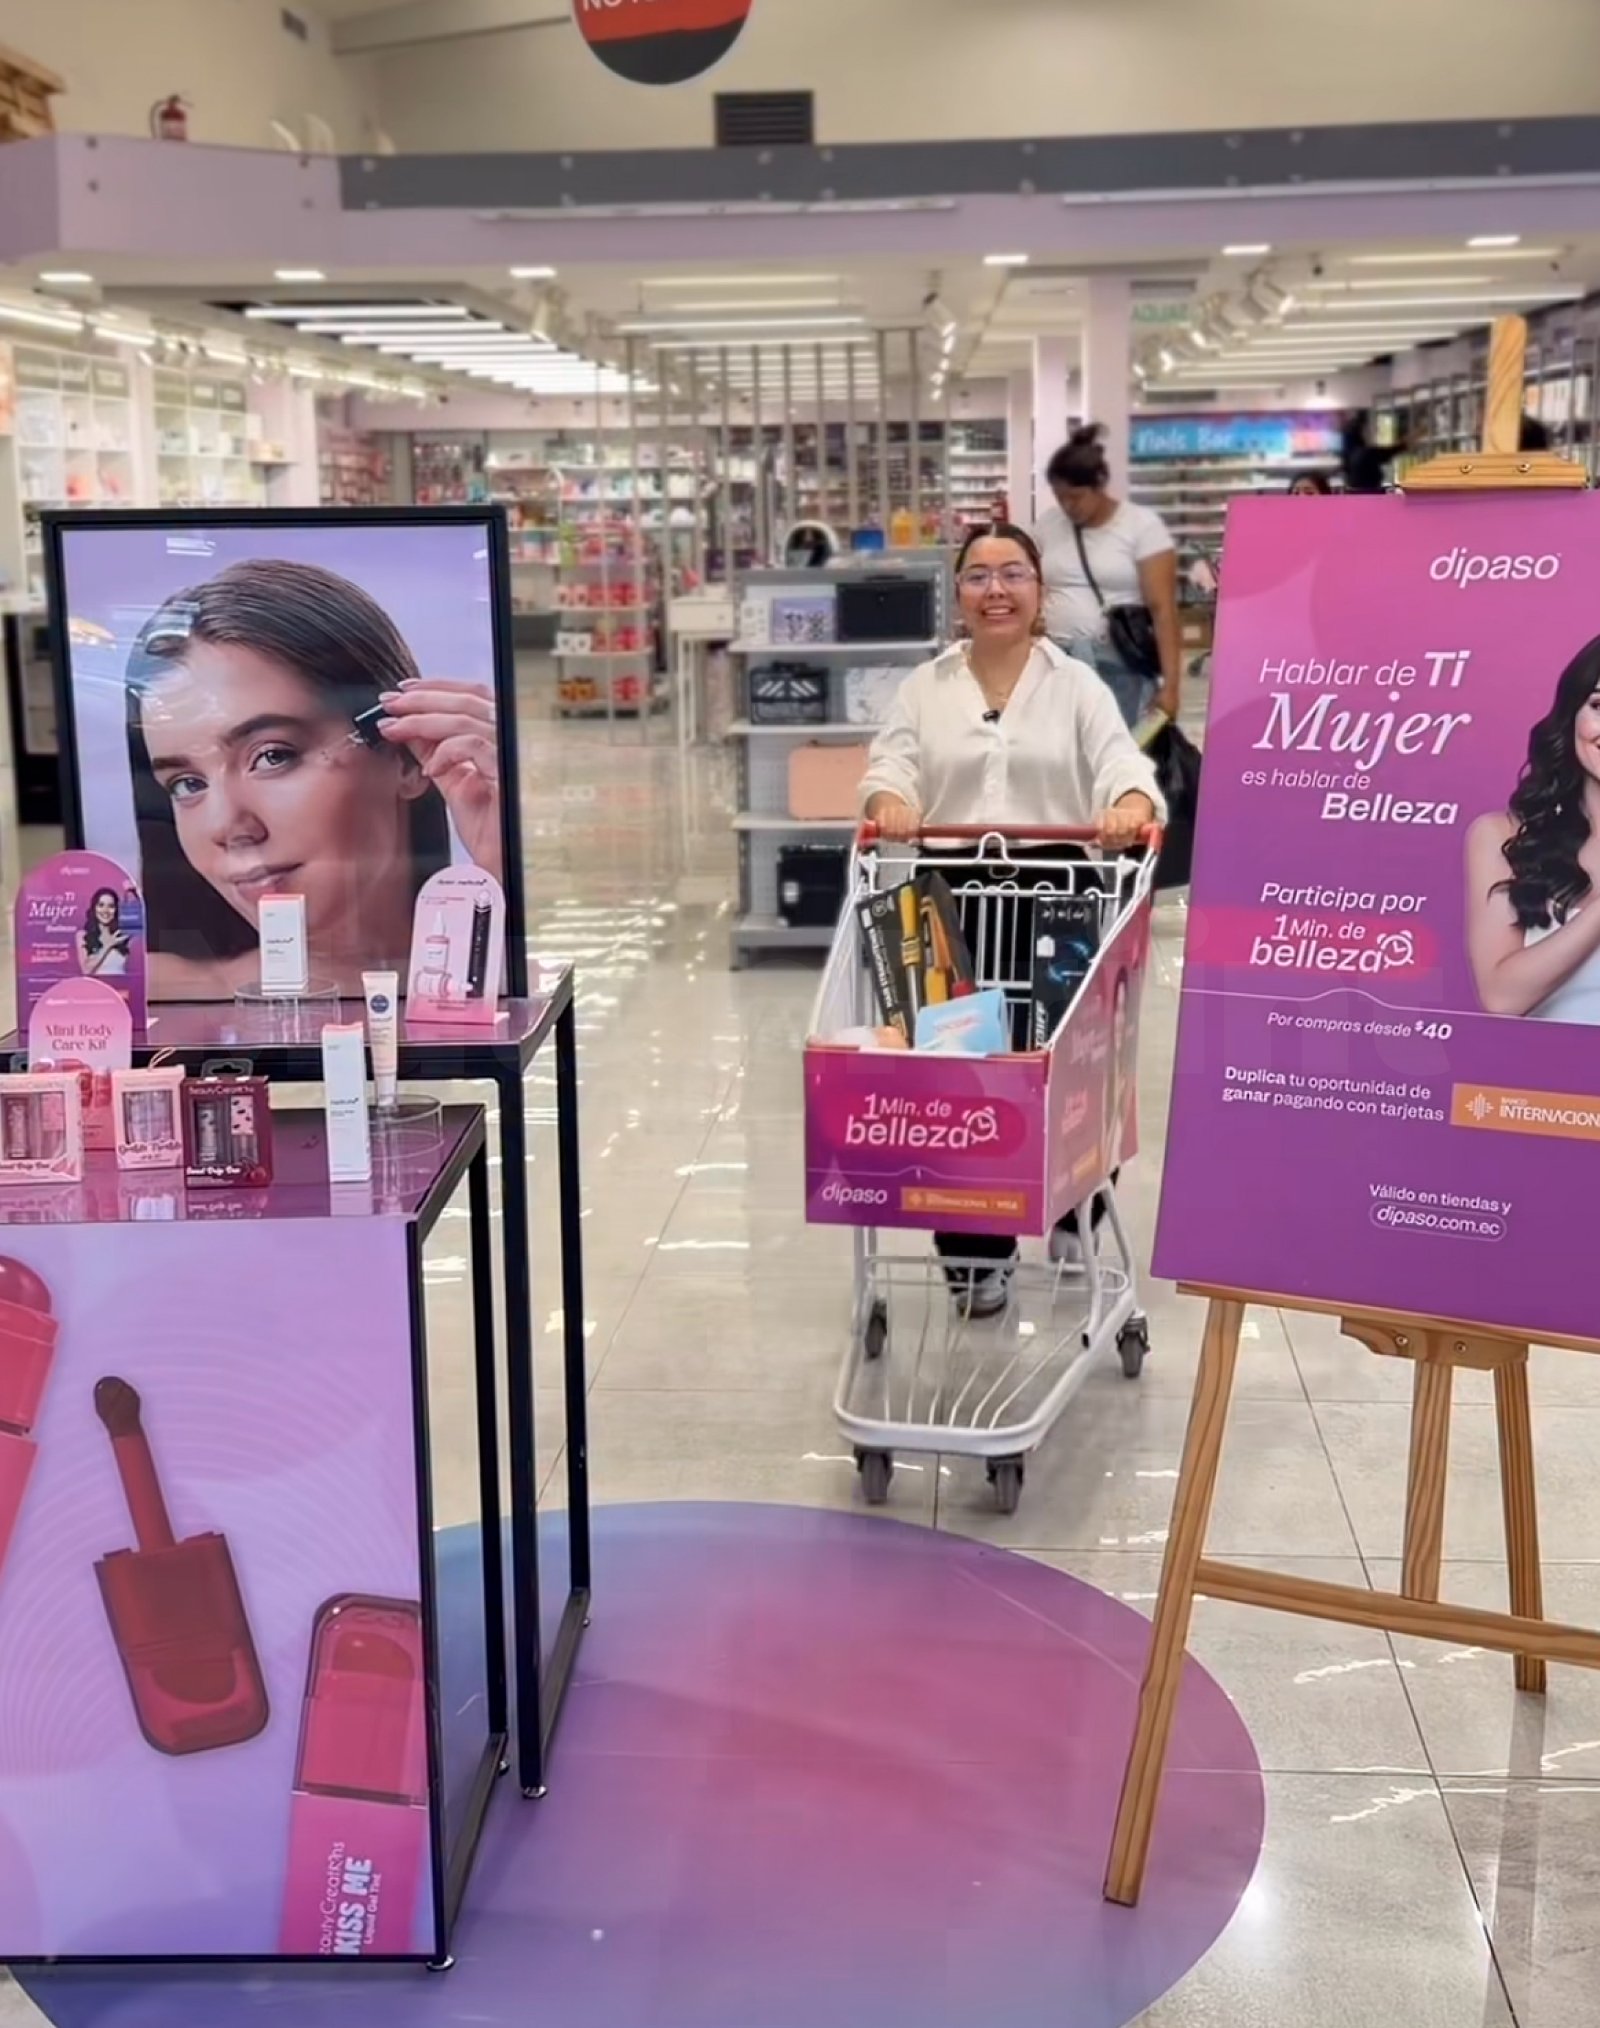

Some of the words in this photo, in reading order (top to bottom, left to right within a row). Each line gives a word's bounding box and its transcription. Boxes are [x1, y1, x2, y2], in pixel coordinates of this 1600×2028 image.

[1429, 548, 1559, 588] dipaso
[1259, 658, 1369, 686] Hablar
[1375, 659, 1416, 686] de
[1425, 650, 1470, 687] Ti
[1252, 691, 1471, 770] Mujer
[1241, 770, 1266, 785] es
[1271, 769, 1339, 788] hablar
[1343, 772, 1370, 789] de
[1321, 793, 1457, 825] Belleza
[30, 902, 78, 922] Mujer
[1260, 883, 1375, 911] Participa
[1380, 893, 1427, 913] por
[1339, 921, 1365, 940] de
[1250, 937, 1382, 973] belleza
[45, 1023, 75, 1038] Mini
[79, 1023, 113, 1041] Body
[1267, 1012, 1293, 1028] Por
[1295, 1016, 1360, 1033] compras
[1364, 1021, 1411, 1038] desde
[1415, 1021, 1452, 1040] $40
[52, 1039, 85, 1051] Care
[88, 1038, 108, 1051] Kit
[1225, 1066, 1286, 1085] Duplica
[1289, 1074, 1305, 1087] tu
[1308, 1076, 1406, 1098] oportunidad
[1409, 1084, 1431, 1100] de
[926, 1098, 951, 1118] de
[1222, 1089, 1271, 1104] ganar
[1273, 1092, 1343, 1114] pagando
[1346, 1099, 1377, 1114] con
[1380, 1102, 1444, 1121] tarjetas
[845, 1114, 969, 1149] belleza
[822, 1182, 888, 1206] dipaso
[1370, 1184, 1415, 1202] Válido
[1418, 1191, 1437, 1204] en
[1441, 1193, 1499, 1211] tiendas
[1501, 1200, 1512, 1215] y
[1377, 1206, 1500, 1236] dipaso.com.ec
[341, 1856, 372, 1896] ME
[333, 1901, 366, 1955] KISS
